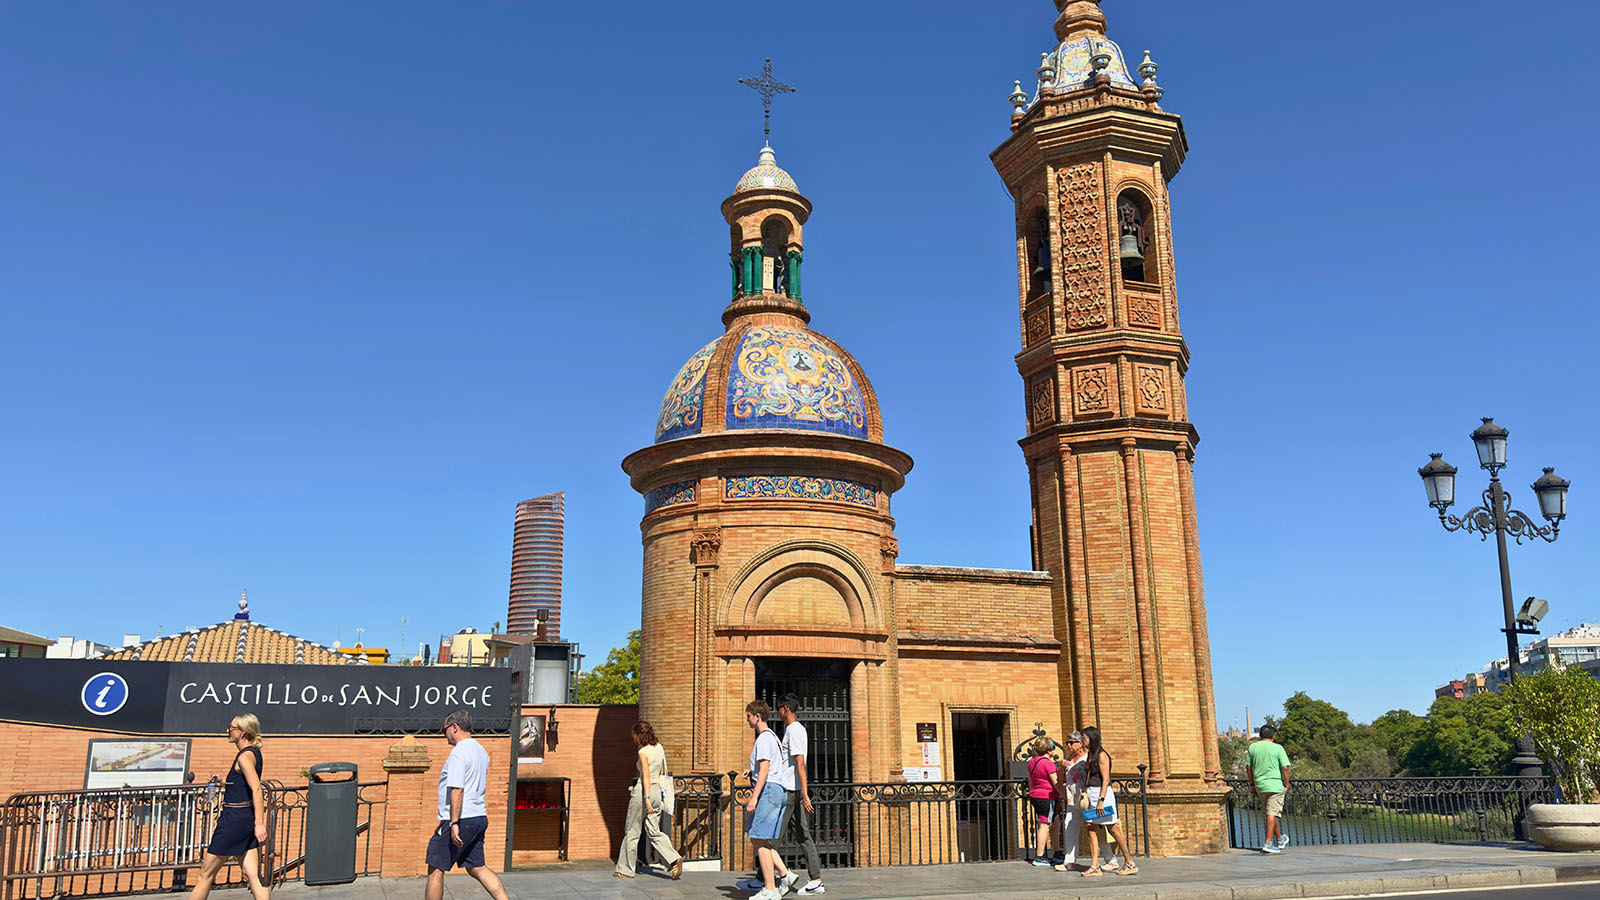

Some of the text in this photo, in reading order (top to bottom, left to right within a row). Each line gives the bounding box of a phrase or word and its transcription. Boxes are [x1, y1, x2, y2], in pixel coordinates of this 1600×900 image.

[180, 682, 493, 709] CASTILLO DE SAN JORGE
